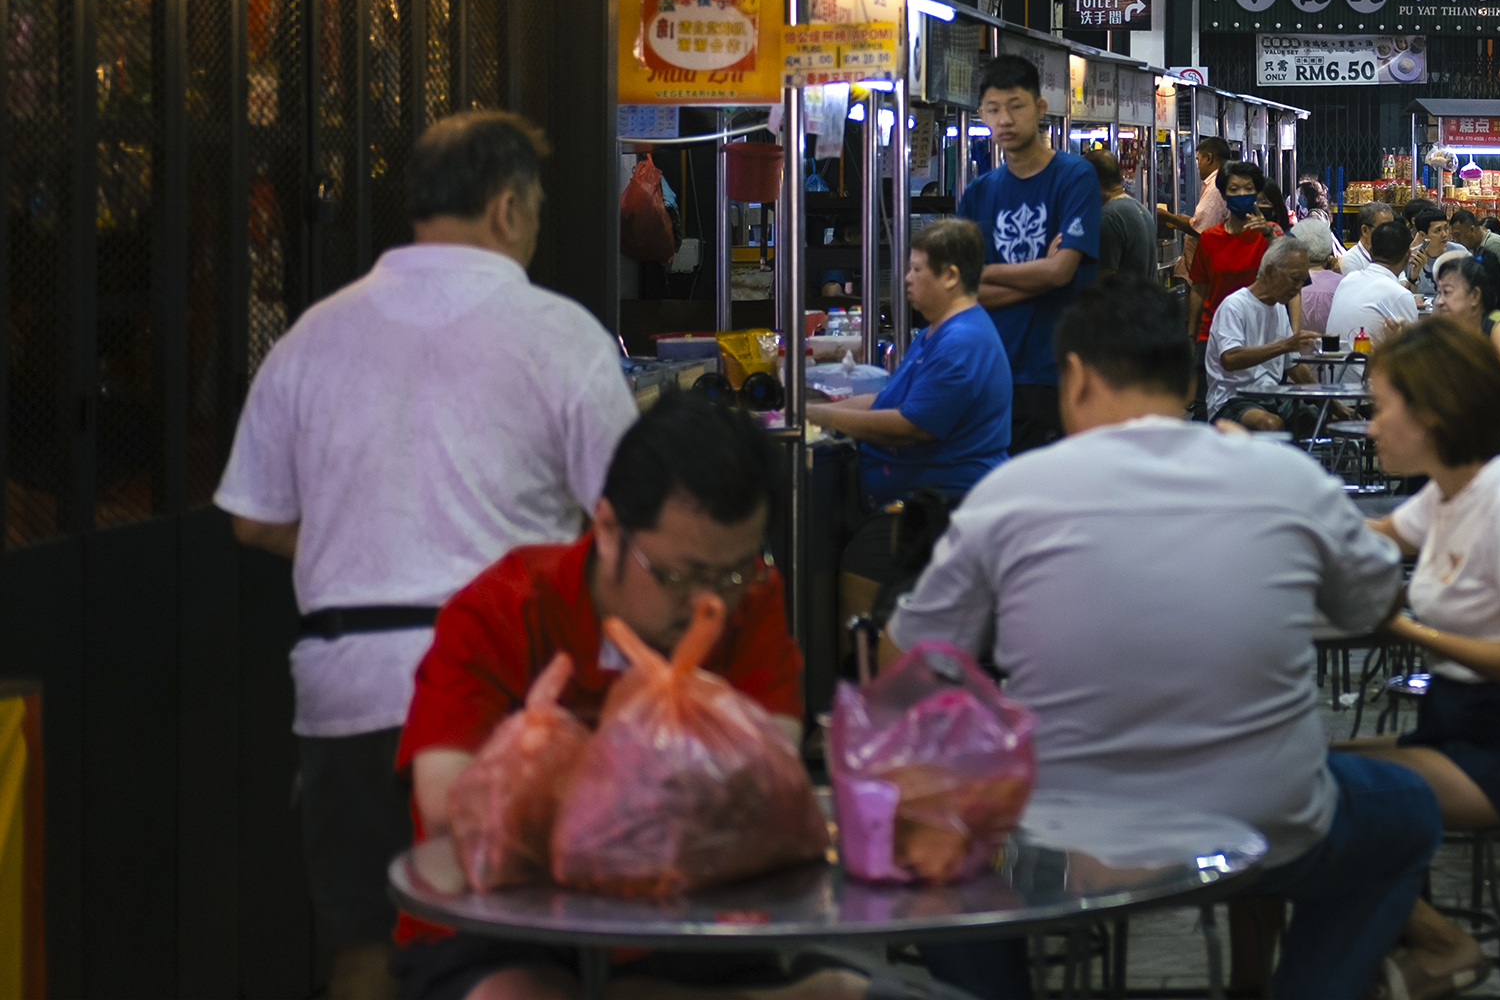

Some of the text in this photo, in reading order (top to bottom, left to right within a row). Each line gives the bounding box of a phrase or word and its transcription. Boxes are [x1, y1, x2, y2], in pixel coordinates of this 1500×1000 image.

[1080, 10, 1122, 26] 洗手間
[1399, 6, 1413, 17] PU
[1417, 6, 1437, 17] YAT
[1441, 6, 1477, 17] THIAN
[1265, 73, 1287, 81] ONLY
[1295, 61, 1375, 81] RM6.50
